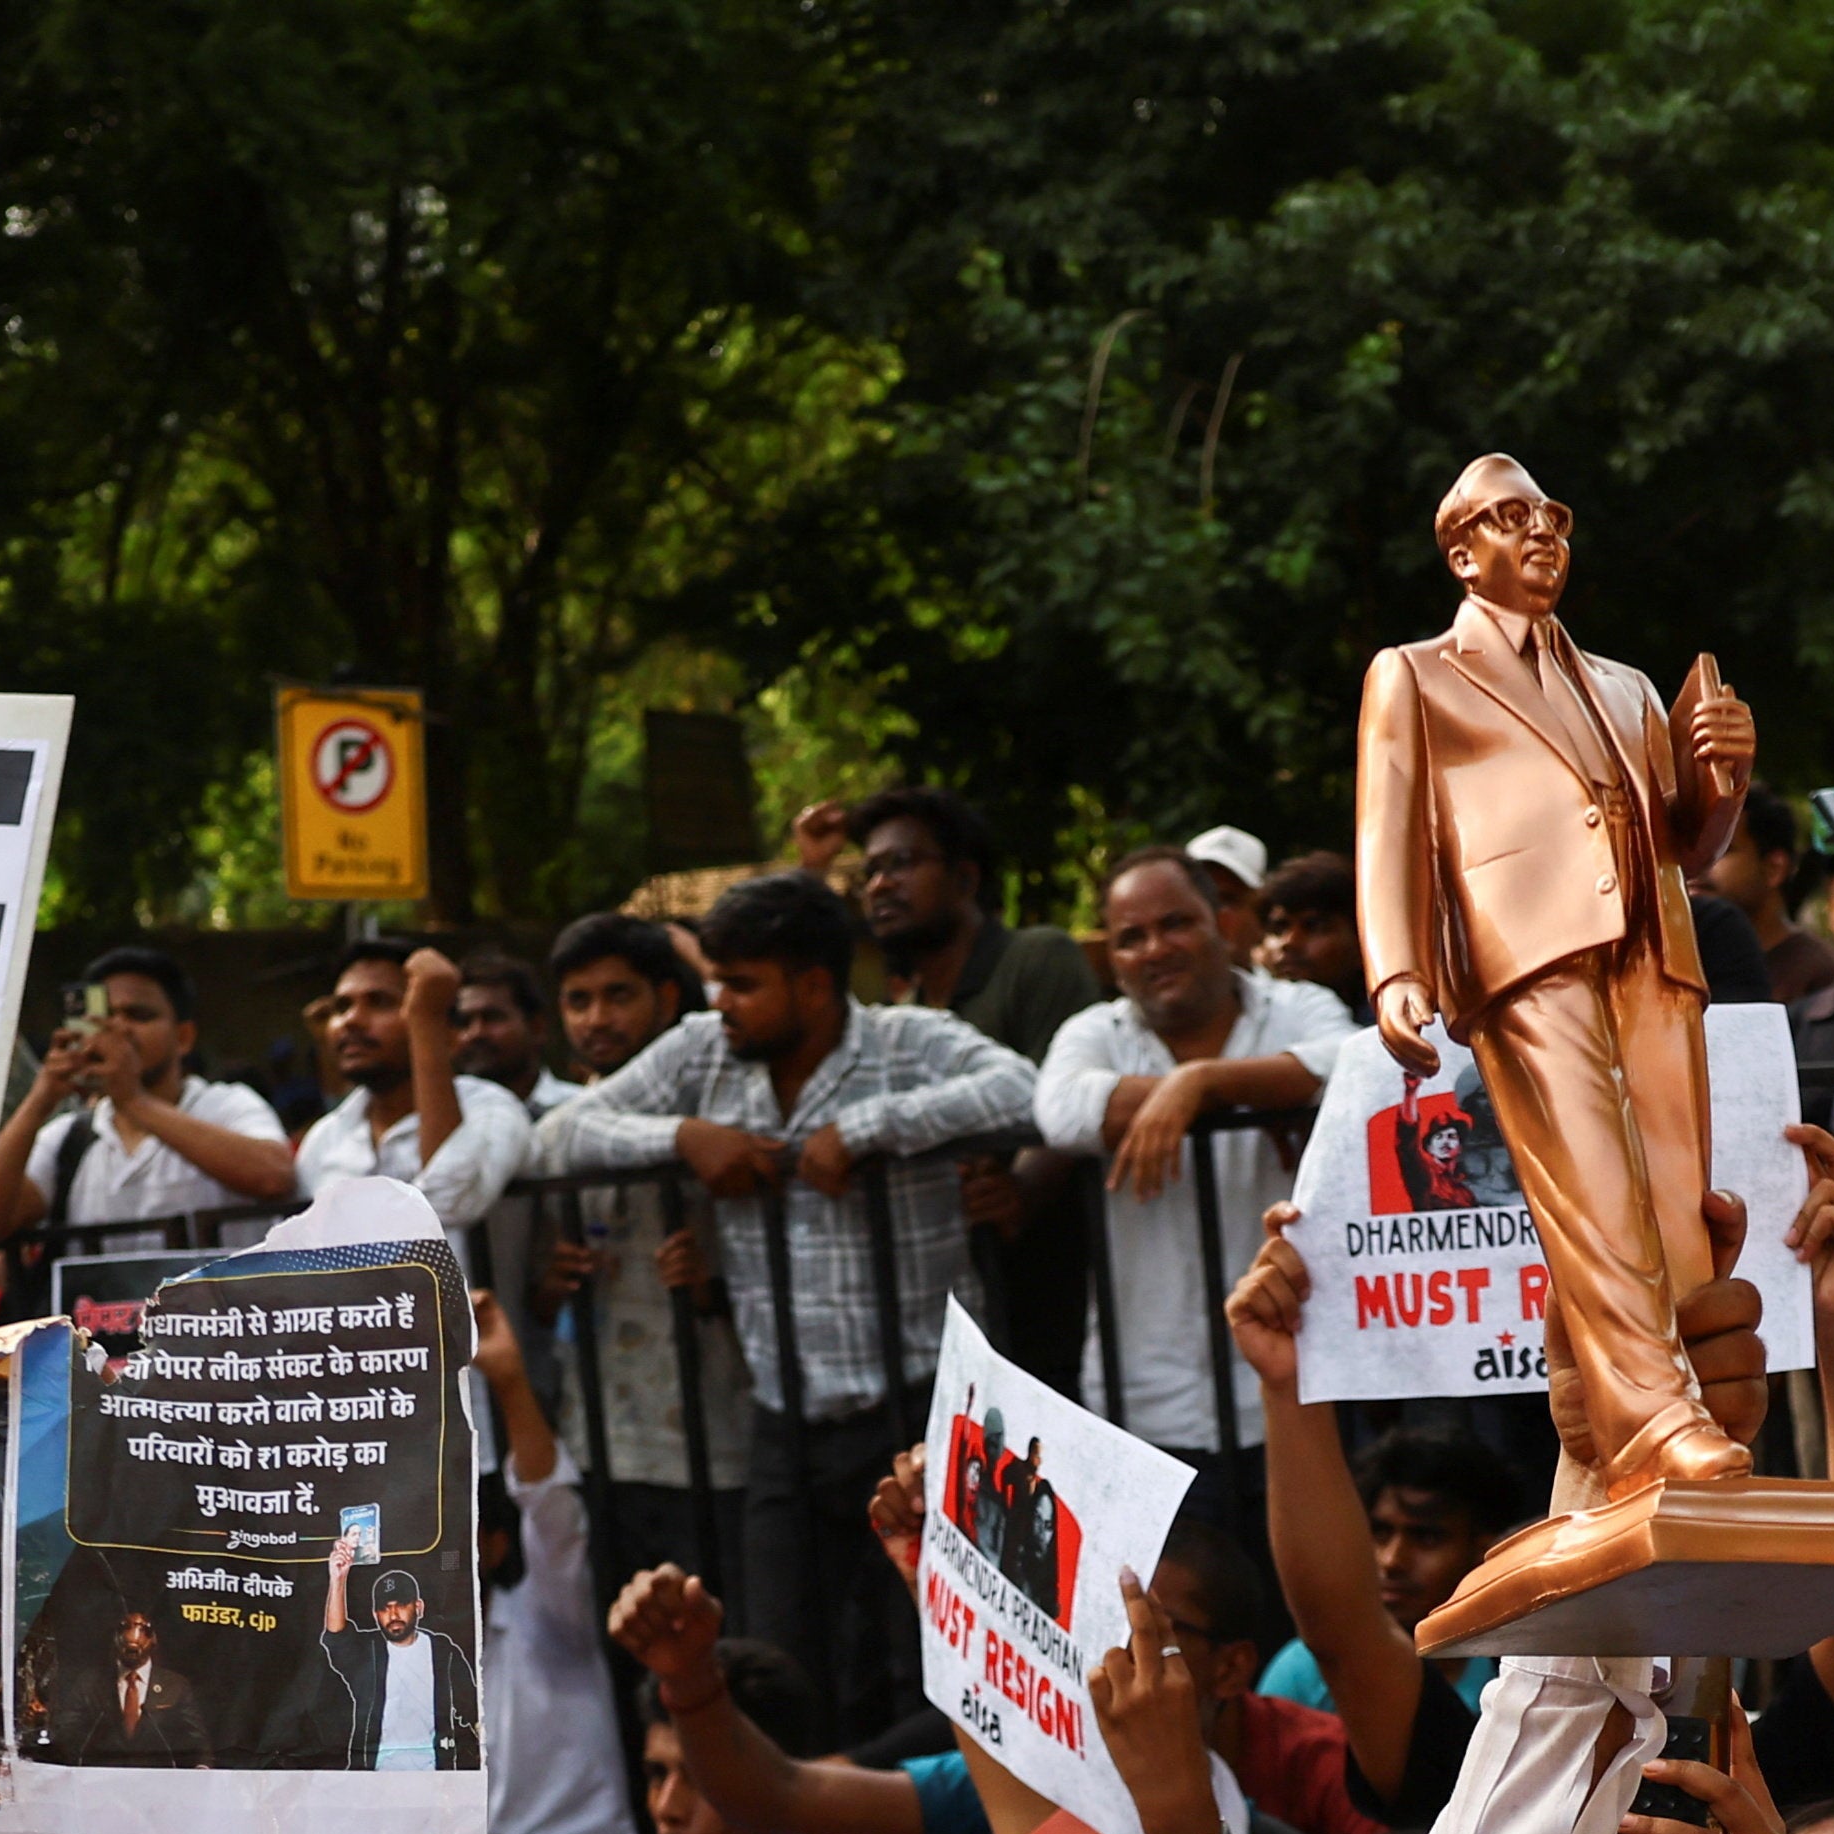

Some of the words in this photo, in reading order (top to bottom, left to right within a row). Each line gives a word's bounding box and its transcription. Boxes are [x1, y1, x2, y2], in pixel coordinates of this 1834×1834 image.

[1347, 1211, 1541, 1257] DHARMENDR
[247, 1304, 268, 1336] से
[272, 1306, 334, 1334] आग्रह
[338, 1296, 394, 1329] करते
[396, 1292, 415, 1330] हैं
[1354, 1268, 1490, 1330] MUST
[154, 1349, 206, 1381] पेपर
[208, 1350, 262, 1381] लीक
[265, 1348, 325, 1380] संकट
[327, 1345, 354, 1376] के
[357, 1347, 429, 1374] कारण
[100, 1393, 214, 1423] आत्महत्या
[217, 1395, 273, 1425] करने
[276, 1391, 325, 1423] वाले
[328, 1388, 387, 1422] छात्रों
[389, 1387, 416, 1419] के
[127, 1435, 215, 1466] परिवारों
[219, 1439, 252, 1470] को
[285, 1440, 348, 1474] करोड़
[353, 1441, 387, 1466] का
[196, 1484, 291, 1517] मुआवजा
[166, 1567, 240, 1593] अभिजीत
[243, 1574, 294, 1599] दीपके
[929, 1509, 1009, 1617] DHARMENDRA
[1010, 1592, 1084, 1687] PRADHAN
[249, 1611, 277, 1632] cjp
[925, 1562, 976, 1661] MUST
[984, 1628, 1086, 1761] RESIGN!
[961, 1681, 1003, 1747] aisa
